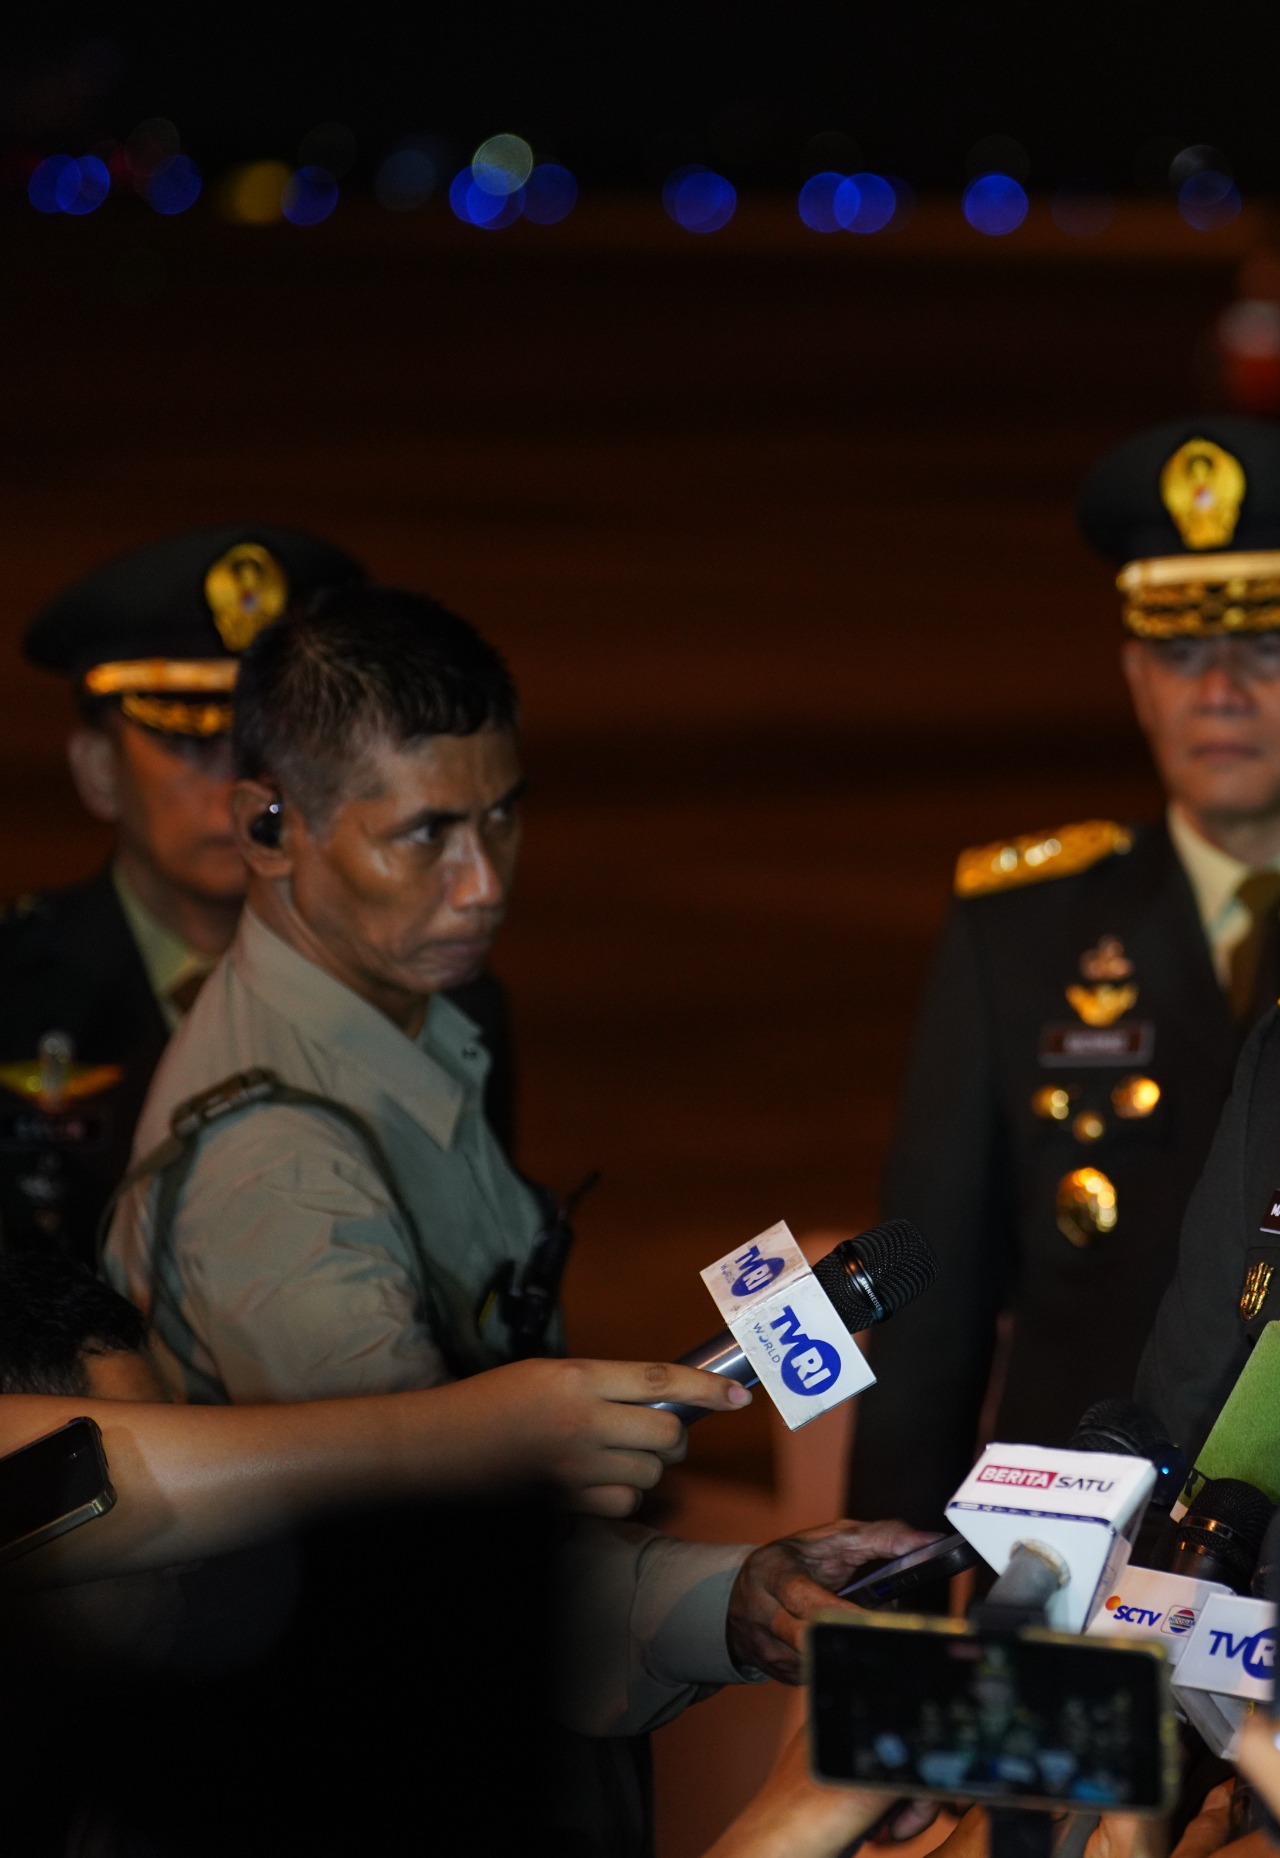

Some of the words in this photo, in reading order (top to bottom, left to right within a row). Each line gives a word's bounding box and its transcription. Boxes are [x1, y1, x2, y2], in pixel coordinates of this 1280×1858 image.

[734, 1244, 776, 1292] TVRI
[860, 1277, 883, 1312] SENNHEISER
[769, 1304, 834, 1391] TVRI
[979, 1466, 1050, 1488] BERITA
[1055, 1476, 1115, 1493] SATU
[1113, 1605, 1162, 1627] SCTV
[1209, 1629, 1278, 1668] TVR
